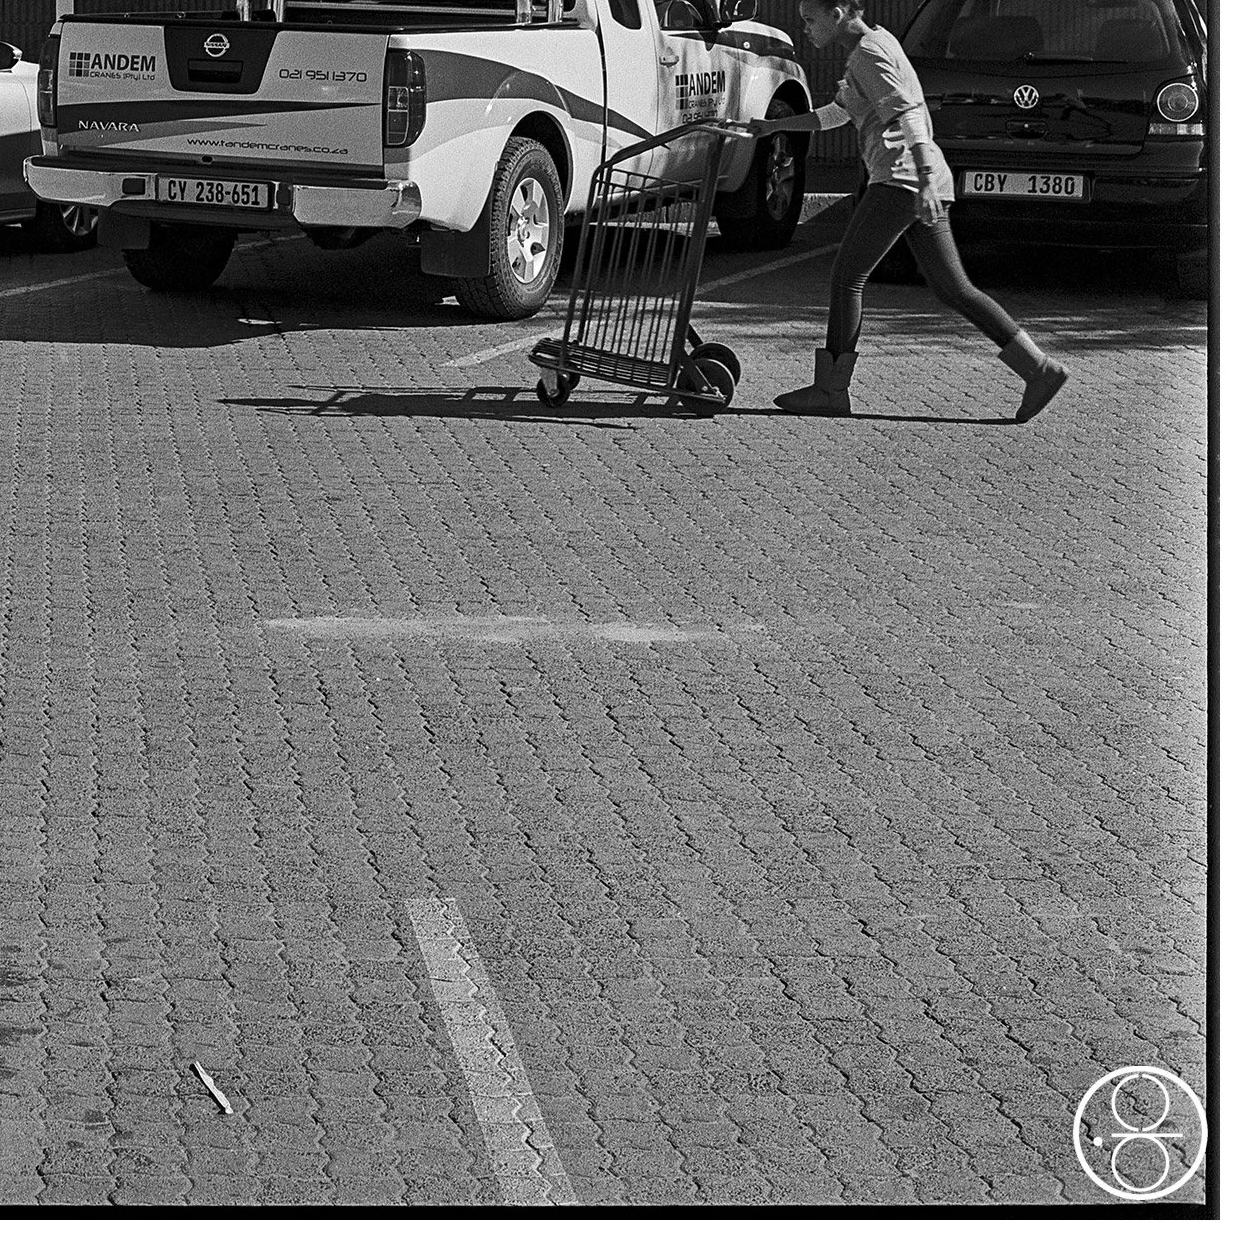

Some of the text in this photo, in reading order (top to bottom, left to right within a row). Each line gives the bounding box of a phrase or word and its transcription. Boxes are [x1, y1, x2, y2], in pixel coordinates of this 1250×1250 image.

[89, 71, 121, 79] CRANES
[279, 69, 368, 83] 021 951 1370
[78, 119, 139, 132] NAVARA
[187, 139, 349, 155] www.tandemcranes.co.za
[973, 173, 1075, 196] CBY 1380
[168, 179, 260, 206] CY 238-651
